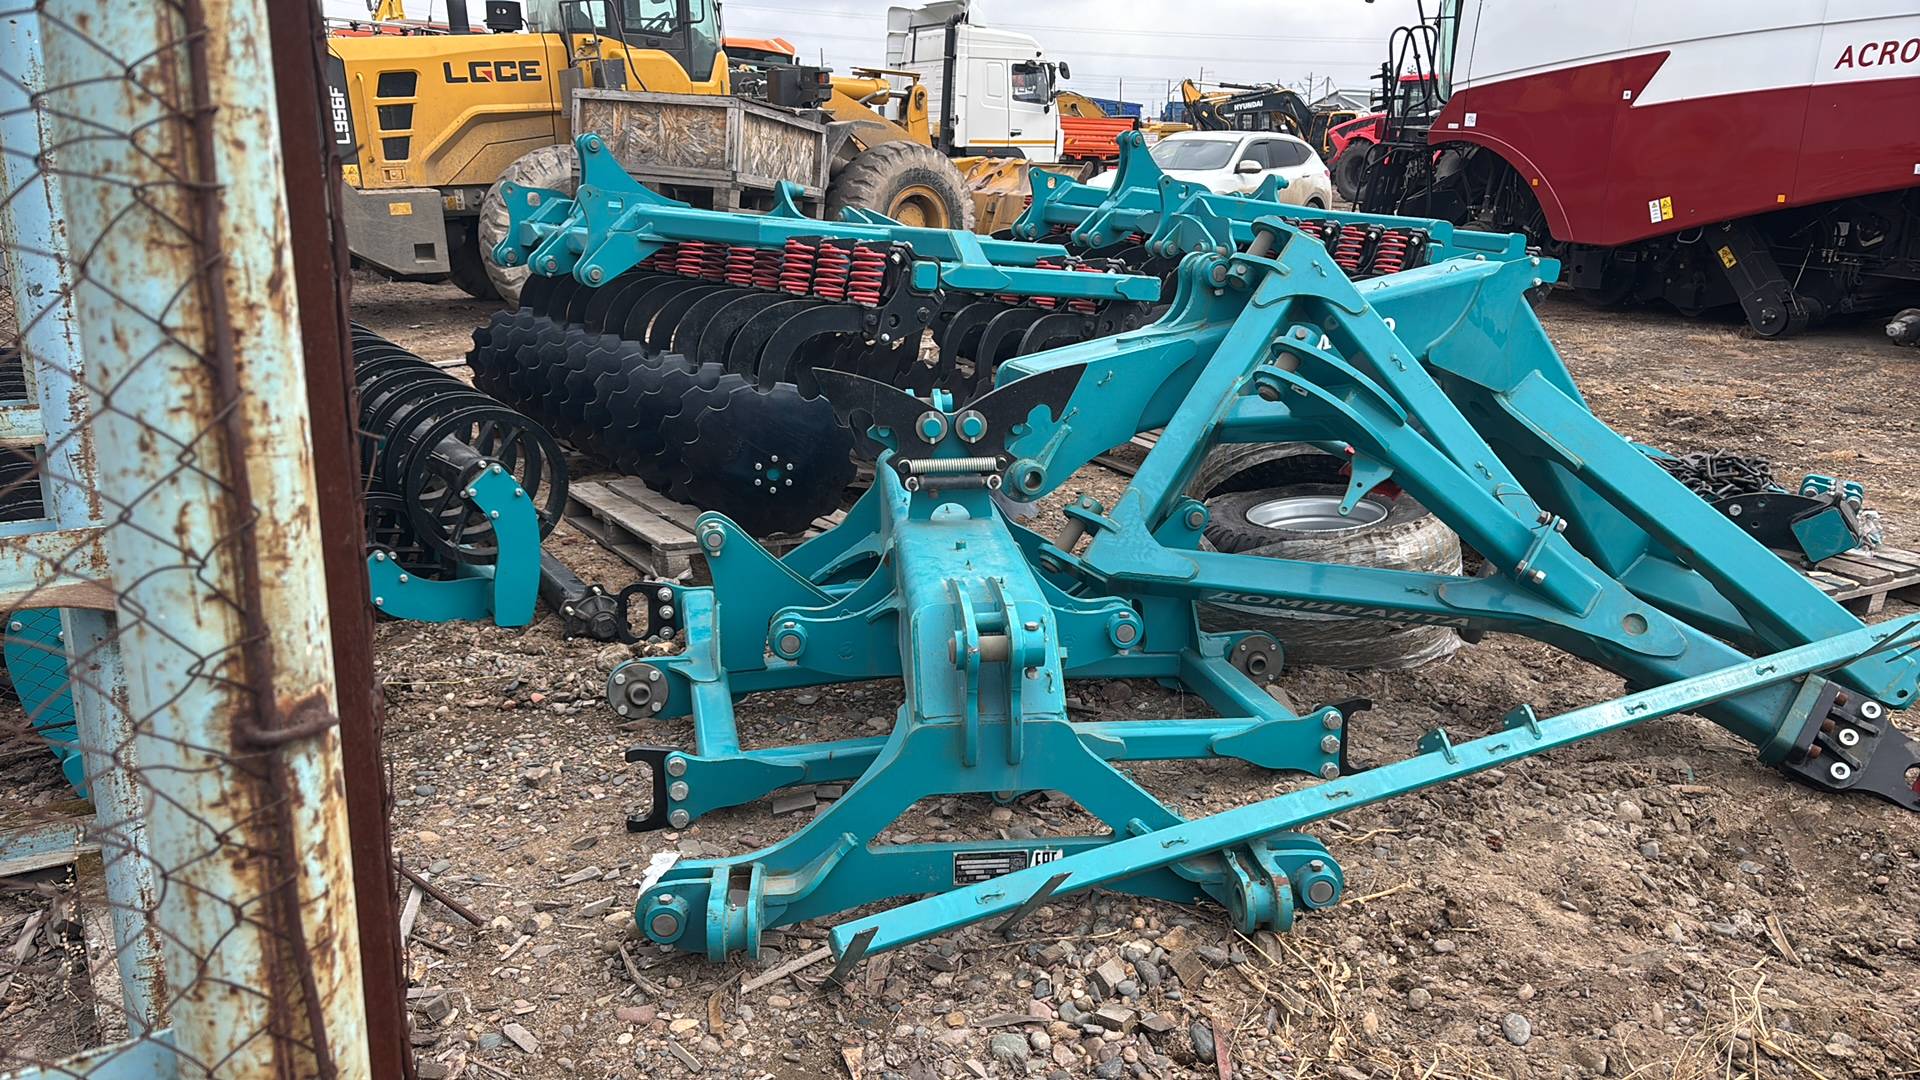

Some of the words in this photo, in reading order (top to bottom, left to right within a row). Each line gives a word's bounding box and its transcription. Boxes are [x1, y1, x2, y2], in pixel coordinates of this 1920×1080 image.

[328, 85, 351, 145] L956F
[1233, 99, 1264, 111] HYUNDAI
[1207, 590, 1471, 627] ДОМИНАНТА
